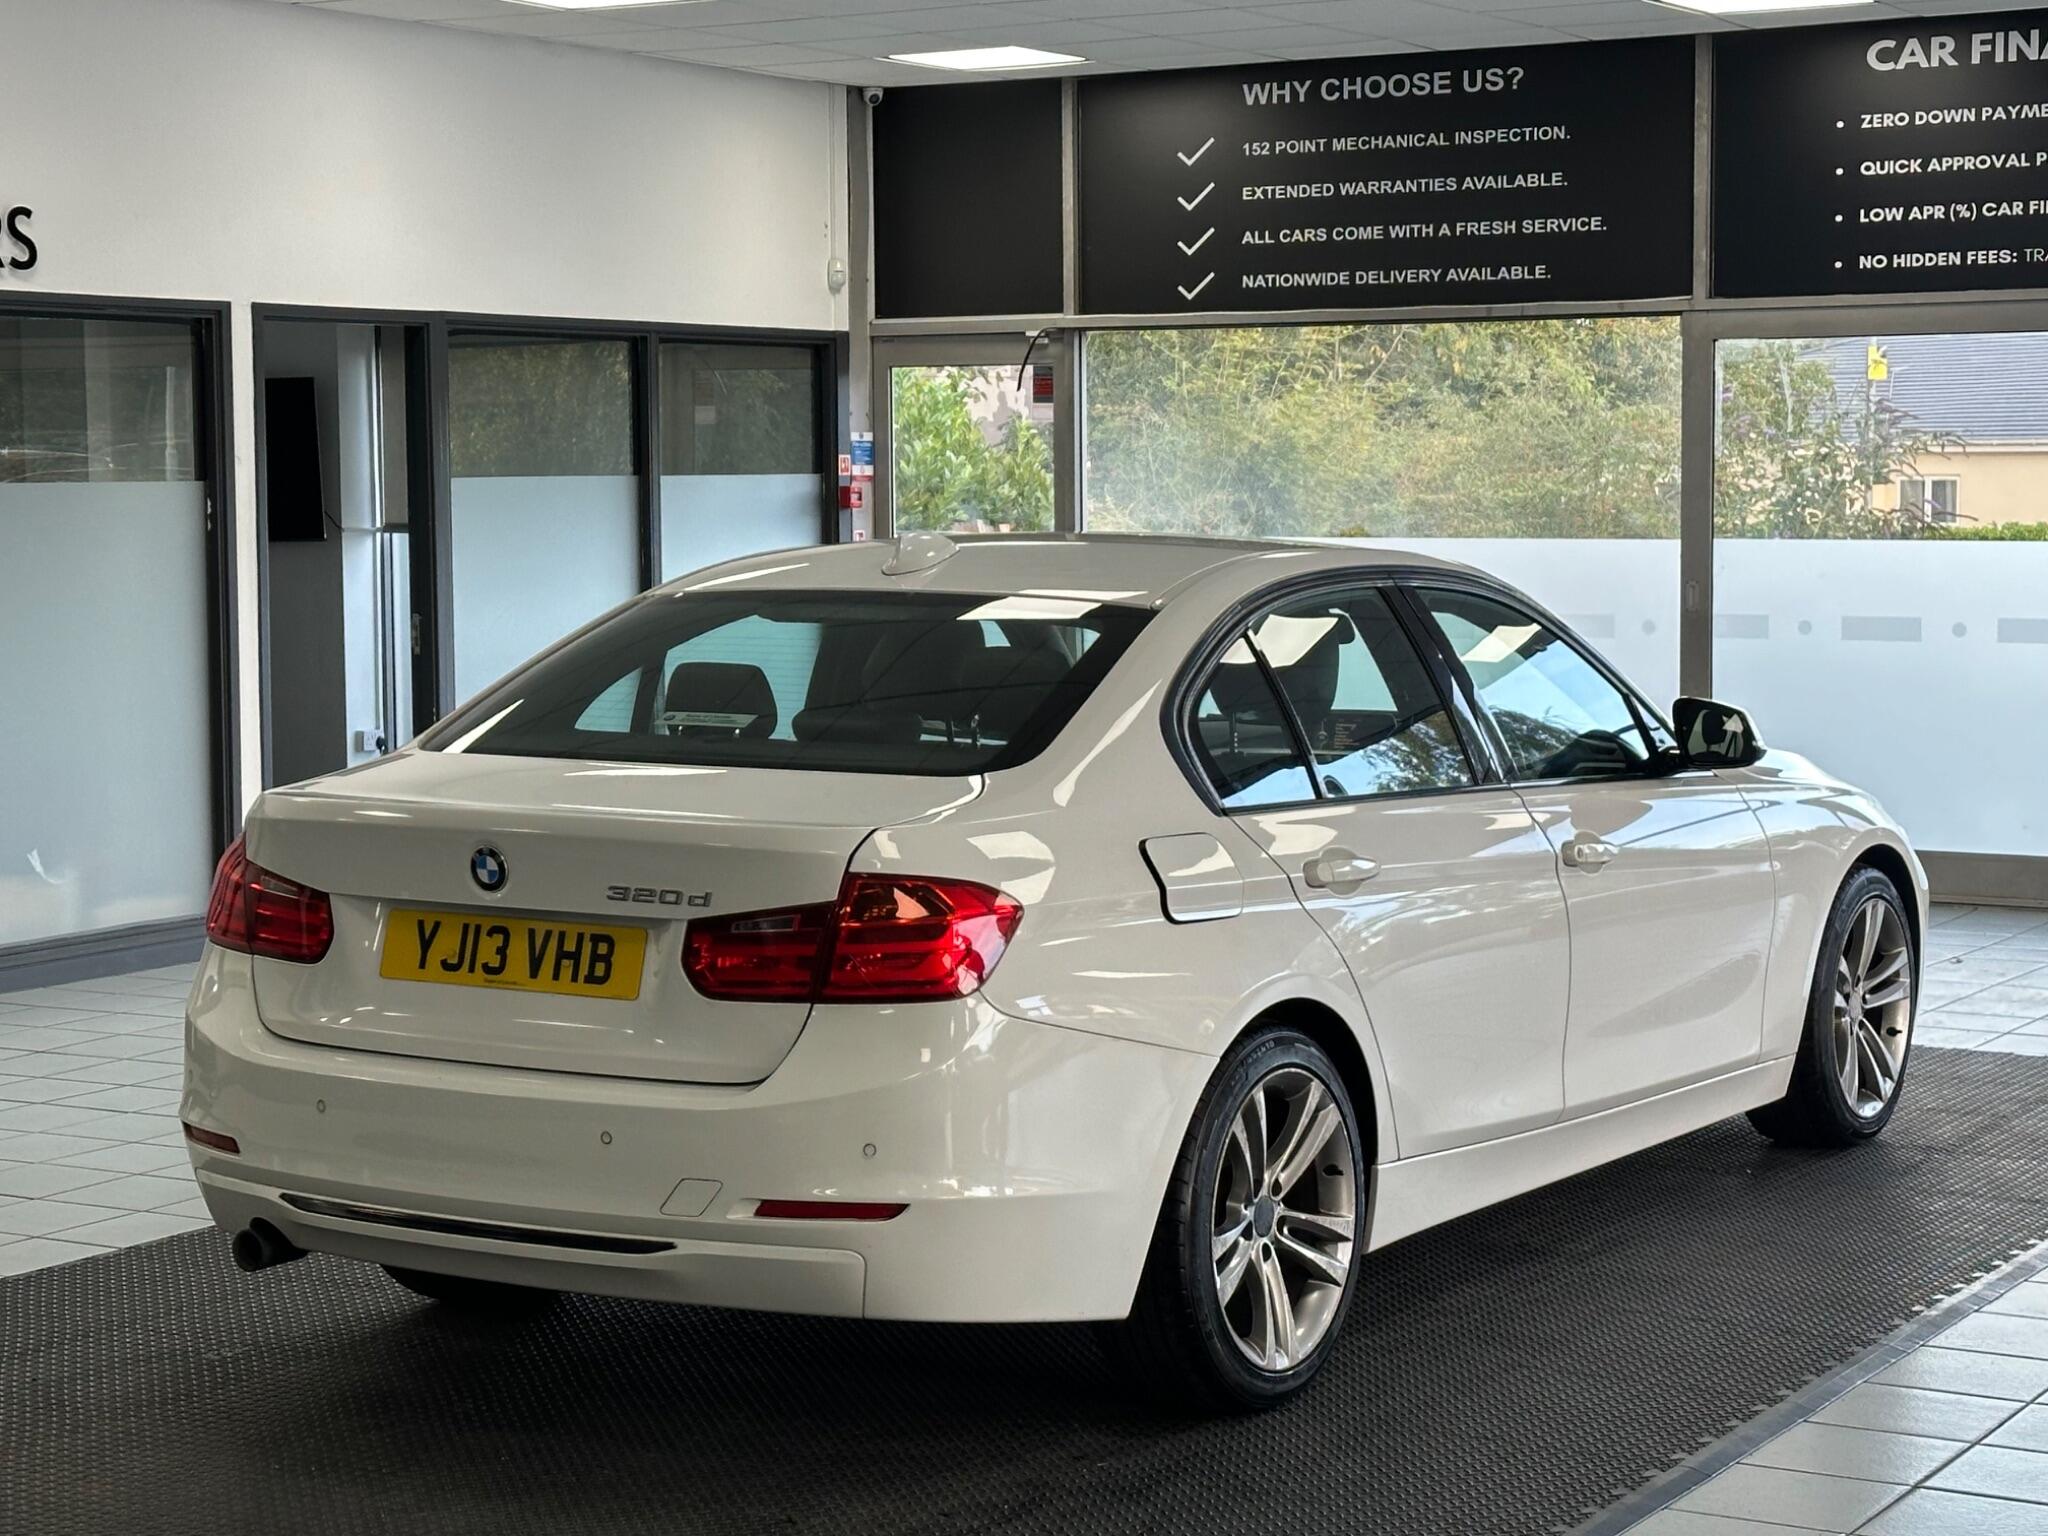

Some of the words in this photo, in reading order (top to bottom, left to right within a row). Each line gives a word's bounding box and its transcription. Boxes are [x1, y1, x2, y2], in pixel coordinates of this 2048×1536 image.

[1866, 35, 1959, 72] CAR
[1970, 29, 2048, 65] FIN
[1242, 79, 1312, 106] WHY
[1320, 71, 1452, 101] CHOOSE
[1463, 66, 1524, 93] US?
[1860, 112, 1910, 129] ZERO
[1914, 107, 1976, 126] DOWN
[1242, 141, 1270, 156] 152
[1275, 138, 1328, 155] POINT
[1332, 132, 1450, 151] MECHANICAL
[1455, 125, 1571, 145] INSPECTION.
[1860, 158, 1923, 176] QUICK
[1926, 152, 2031, 173] APPROVAL
[1242, 183, 1335, 201] EXTENDED
[1338, 177, 1458, 196] WARRANTIES
[1461, 172, 1568, 190] AVAILABLE.
[1859, 206, 1904, 223] LOW
[1908, 205, 1945, 221] APR
[1949, 202, 1977, 222] (%)
[1981, 201, 2024, 217] CAR
[2029, 199, 2048, 215] FI
[0, 205, 38, 271] S
[1241, 230, 1275, 245] ALL
[1279, 227, 1327, 243] CARS
[1332, 225, 1384, 241] COME
[1388, 223, 1434, 239] WITH
[1438, 223, 1452, 237] A
[1456, 220, 1516, 236] FRESH
[1521, 216, 1607, 234] SERVICE.
[1859, 254, 1888, 269] NO
[1892, 251, 1961, 268] HIDDEN
[1966, 249, 2018, 265] FEES:
[1242, 271, 1350, 288] NATIONWIDE
[1355, 268, 1442, 285] DELIVERY
[1445, 264, 1551, 282] AVAILABLE.
[606, 885, 713, 908] 320d
[416, 918, 512, 977] YJ13
[527, 927, 617, 986] VHB
